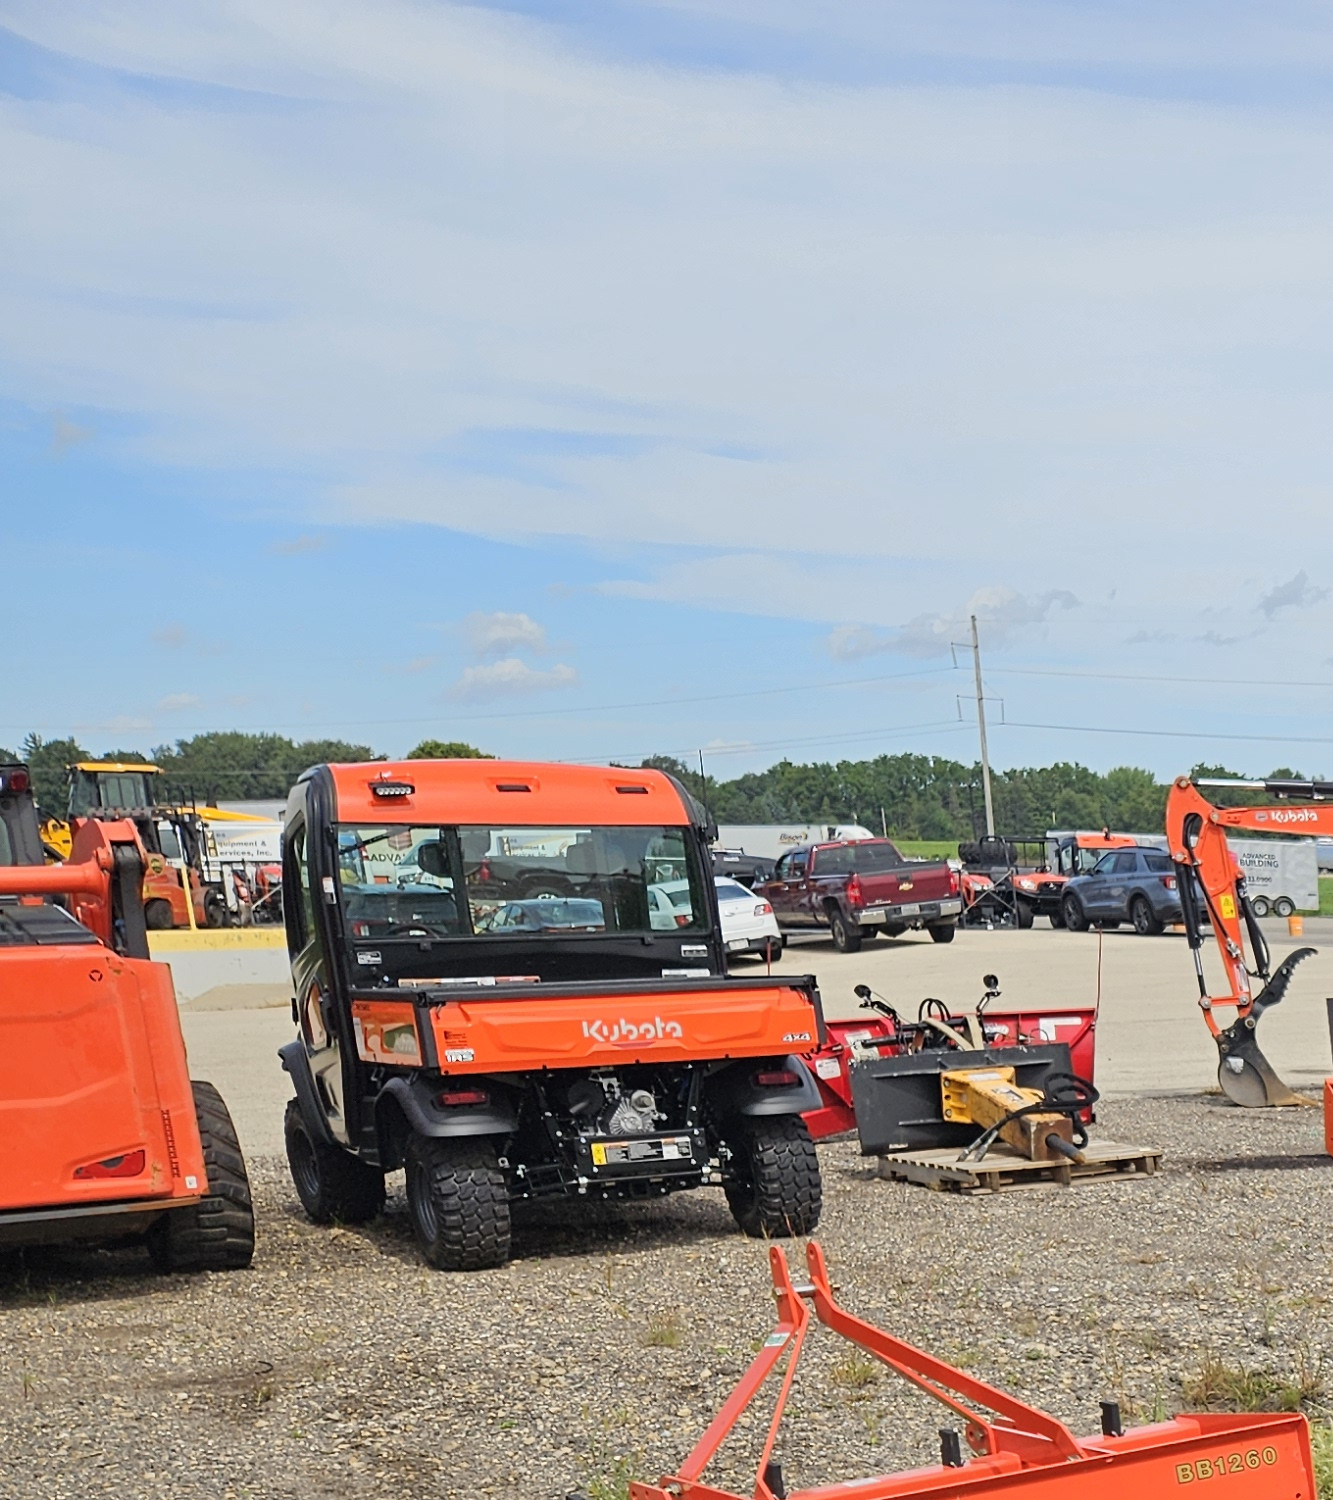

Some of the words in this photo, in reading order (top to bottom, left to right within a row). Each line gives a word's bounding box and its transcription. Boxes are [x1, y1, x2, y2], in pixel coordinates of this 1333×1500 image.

[1271, 809, 1318, 823] Kubota
[1239, 859, 1280, 868] BUILDING
[581, 1016, 683, 1042] Kubota
[1175, 1446, 1279, 1484] BB1260
